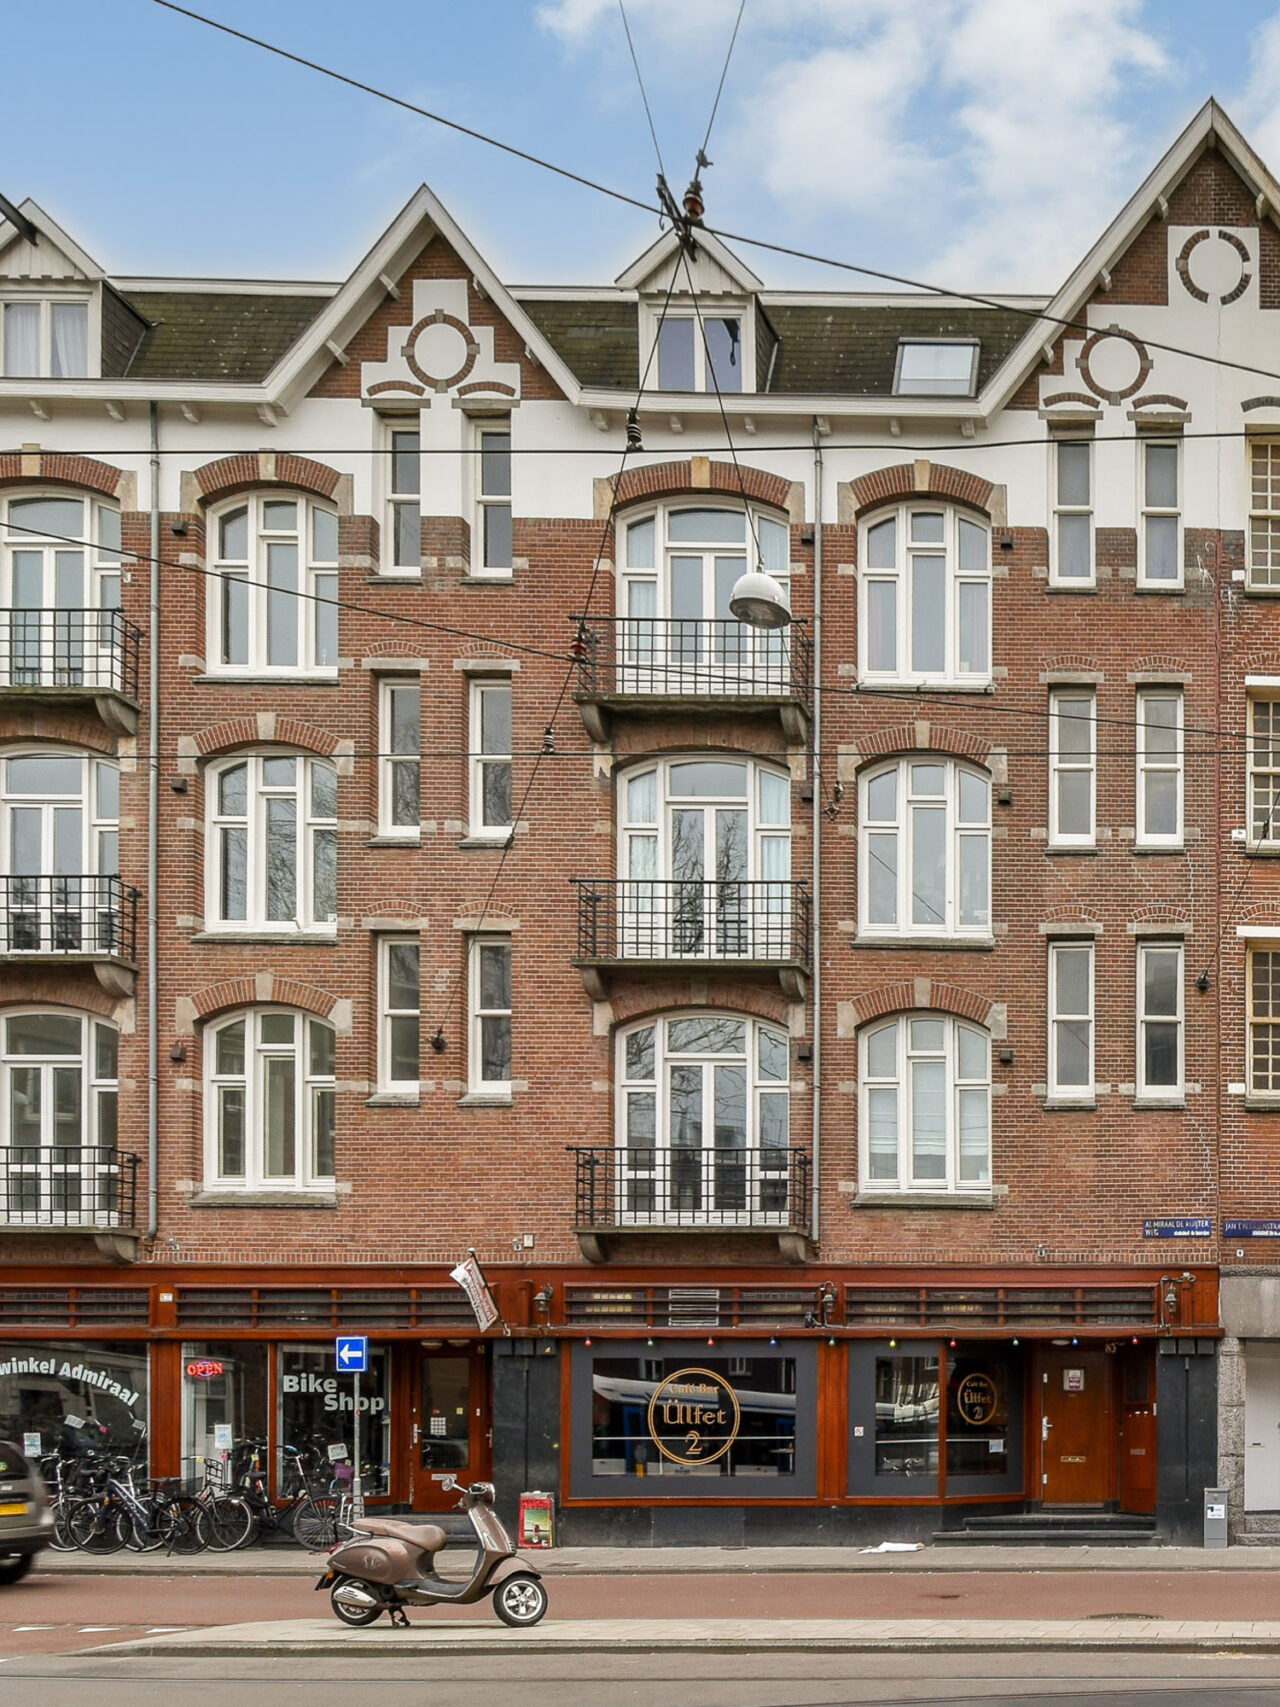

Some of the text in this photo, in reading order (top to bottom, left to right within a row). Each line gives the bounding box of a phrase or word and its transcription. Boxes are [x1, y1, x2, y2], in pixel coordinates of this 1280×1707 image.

[187, 1362, 223, 1376] OPEN
[59, 1362, 140, 1406] Admiraal
[283, 1373, 338, 1393] Bike
[699, 1383, 720, 1394] Bar
[324, 1392, 385, 1415] Shop
[963, 1389, 992, 1404] Ülfet
[663, 1399, 727, 1425] Ülfet
[684, 1430, 703, 1455] 2
